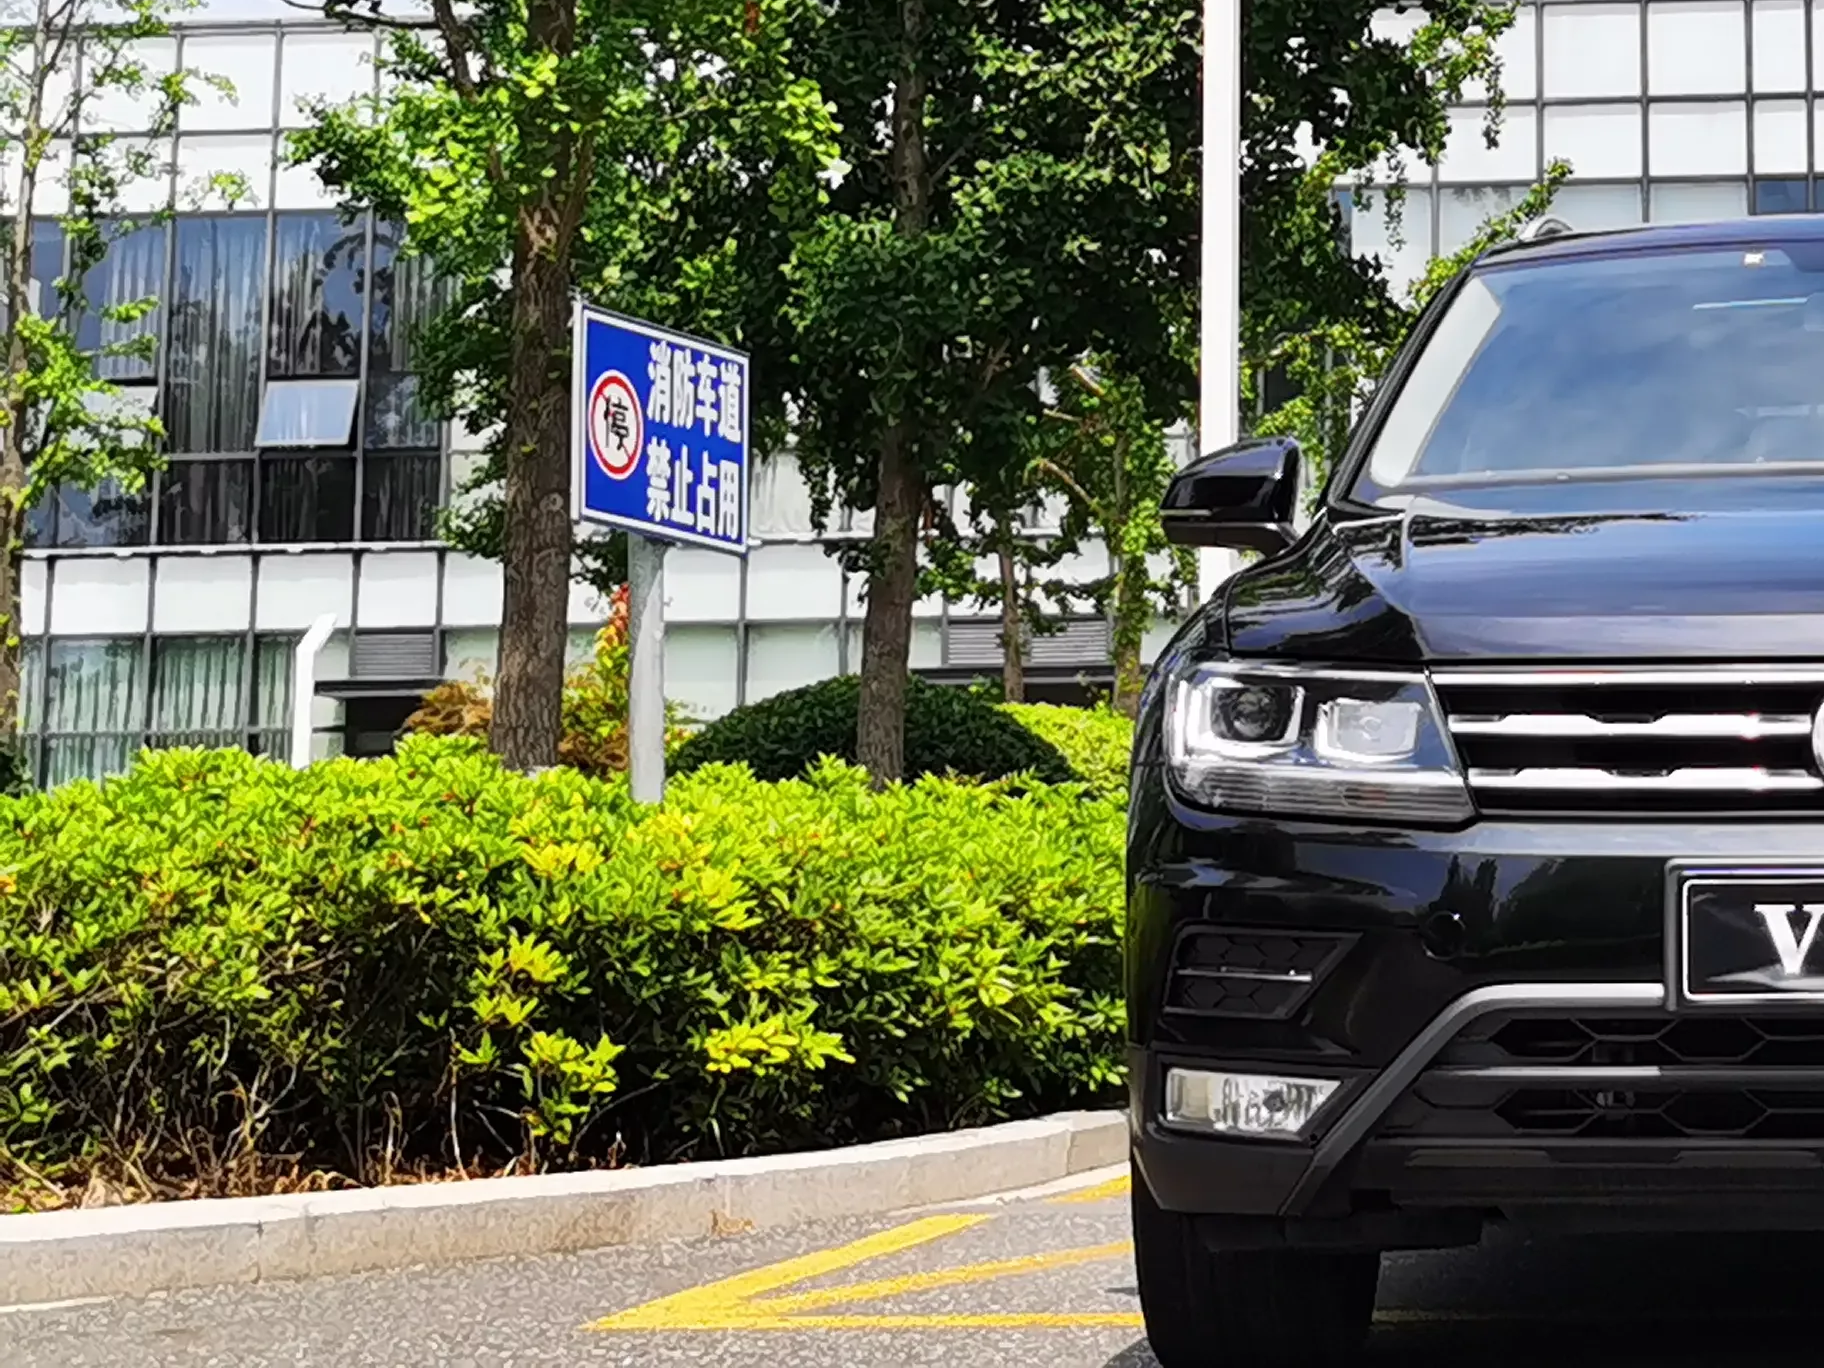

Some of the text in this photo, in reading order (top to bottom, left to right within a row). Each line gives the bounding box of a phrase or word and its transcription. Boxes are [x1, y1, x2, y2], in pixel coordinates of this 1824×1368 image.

[647, 340, 741, 443] 消防车道
[646, 436, 740, 540] 禁止占用
